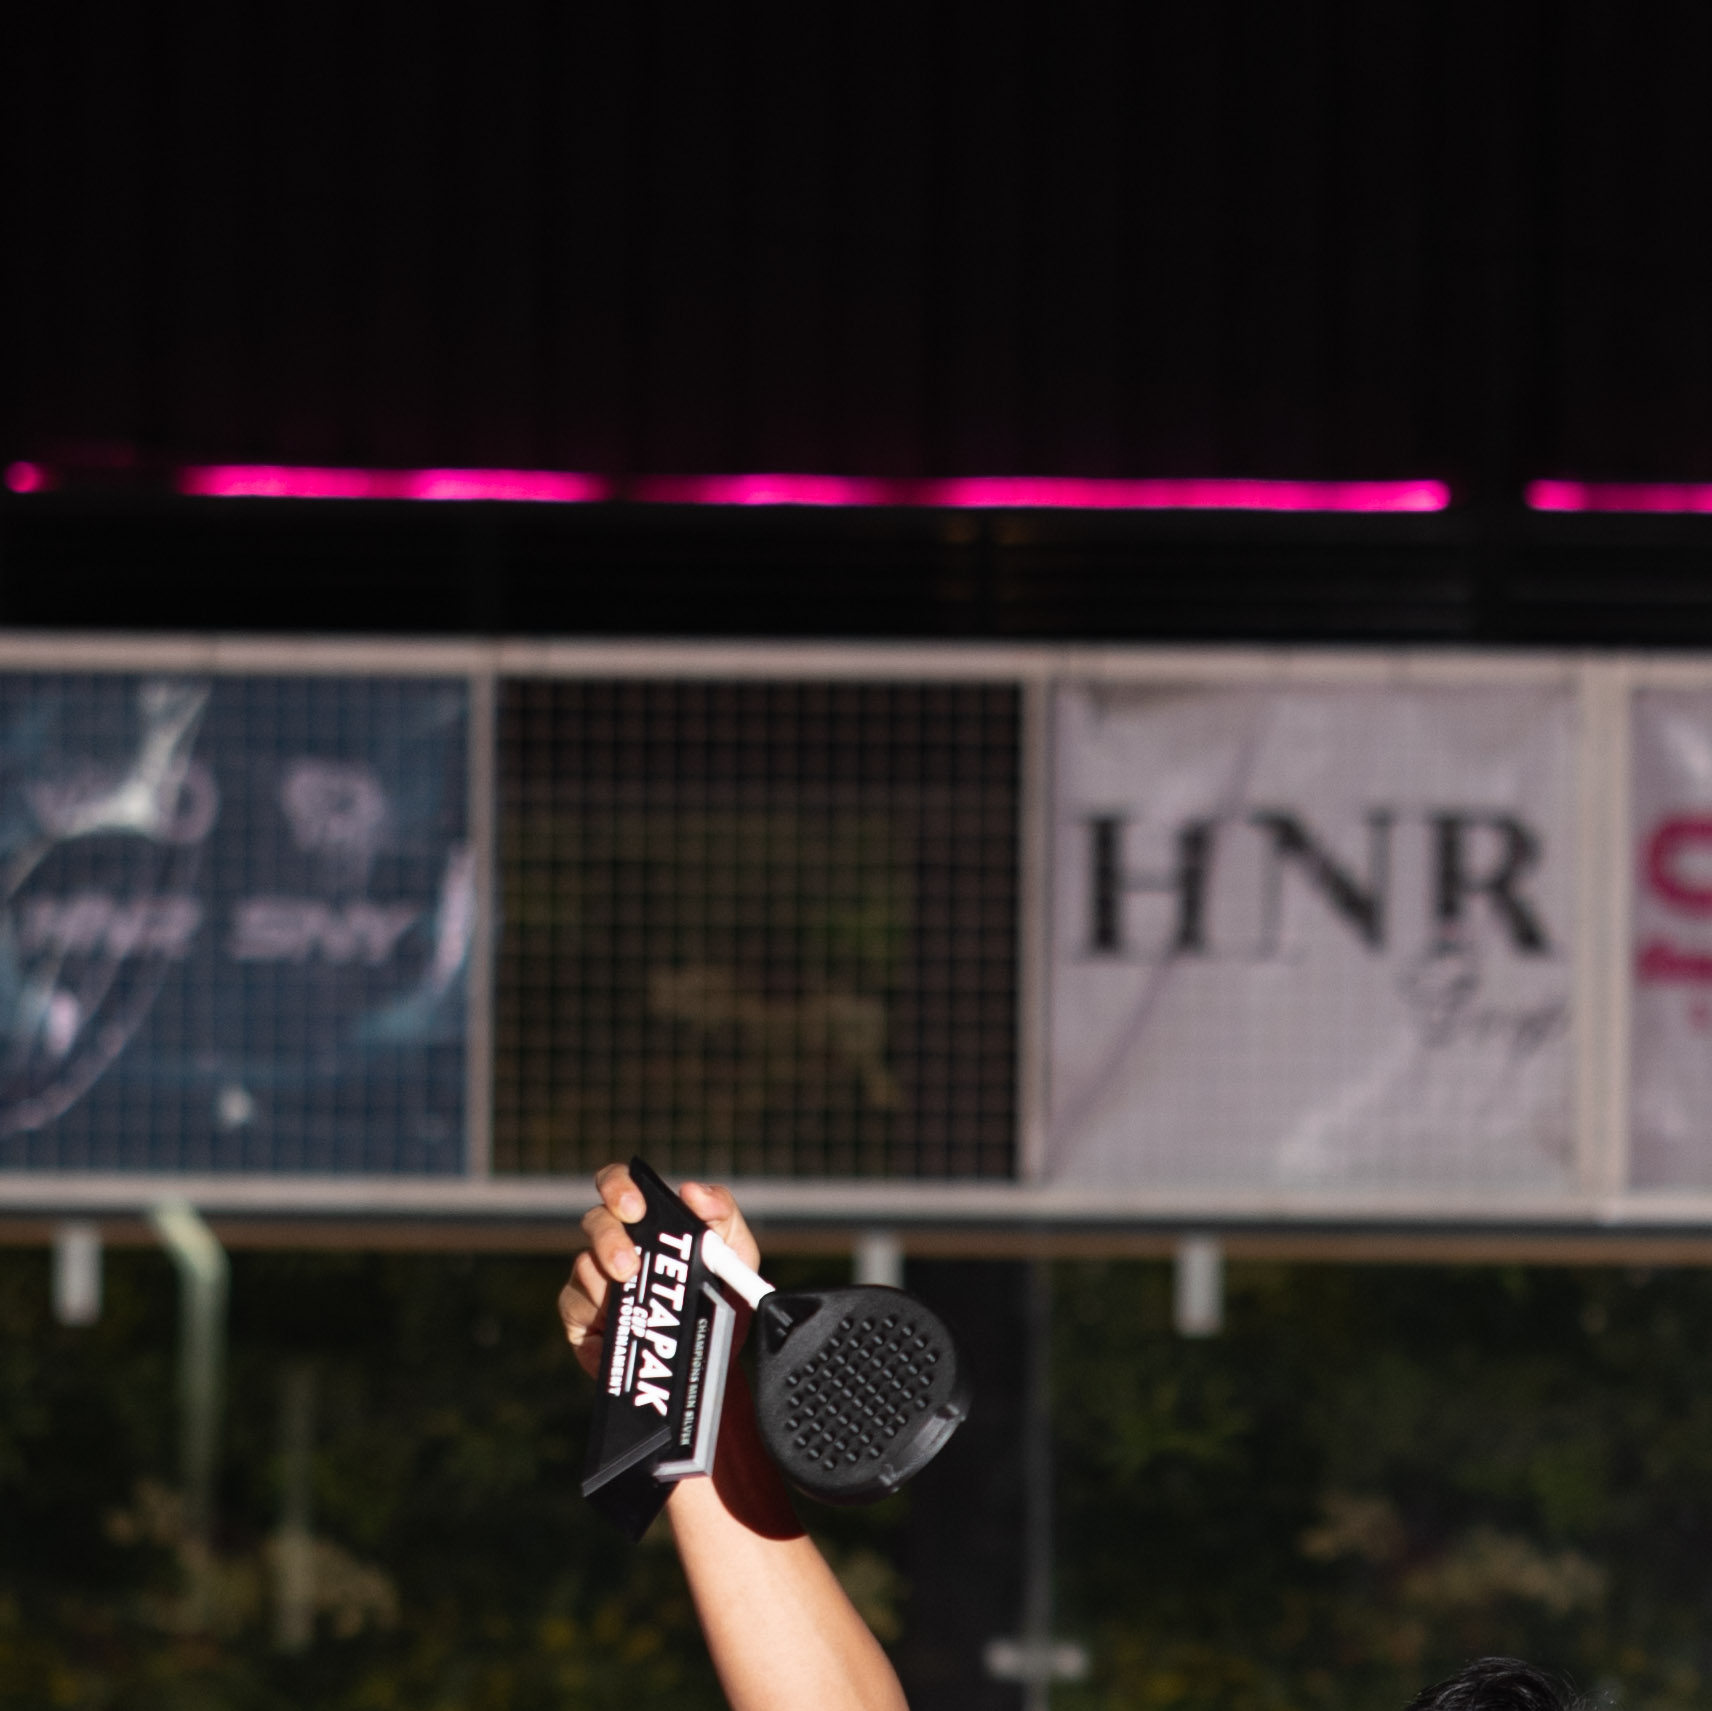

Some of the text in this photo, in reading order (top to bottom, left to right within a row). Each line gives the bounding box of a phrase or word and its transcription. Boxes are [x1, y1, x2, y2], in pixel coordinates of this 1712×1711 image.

[1073, 811, 1558, 960] HNR
[608, 1296, 635, 1397] TOURNAMENT
[630, 1305, 648, 1338] CUP
[634, 1232, 692, 1417] TETAPAK
